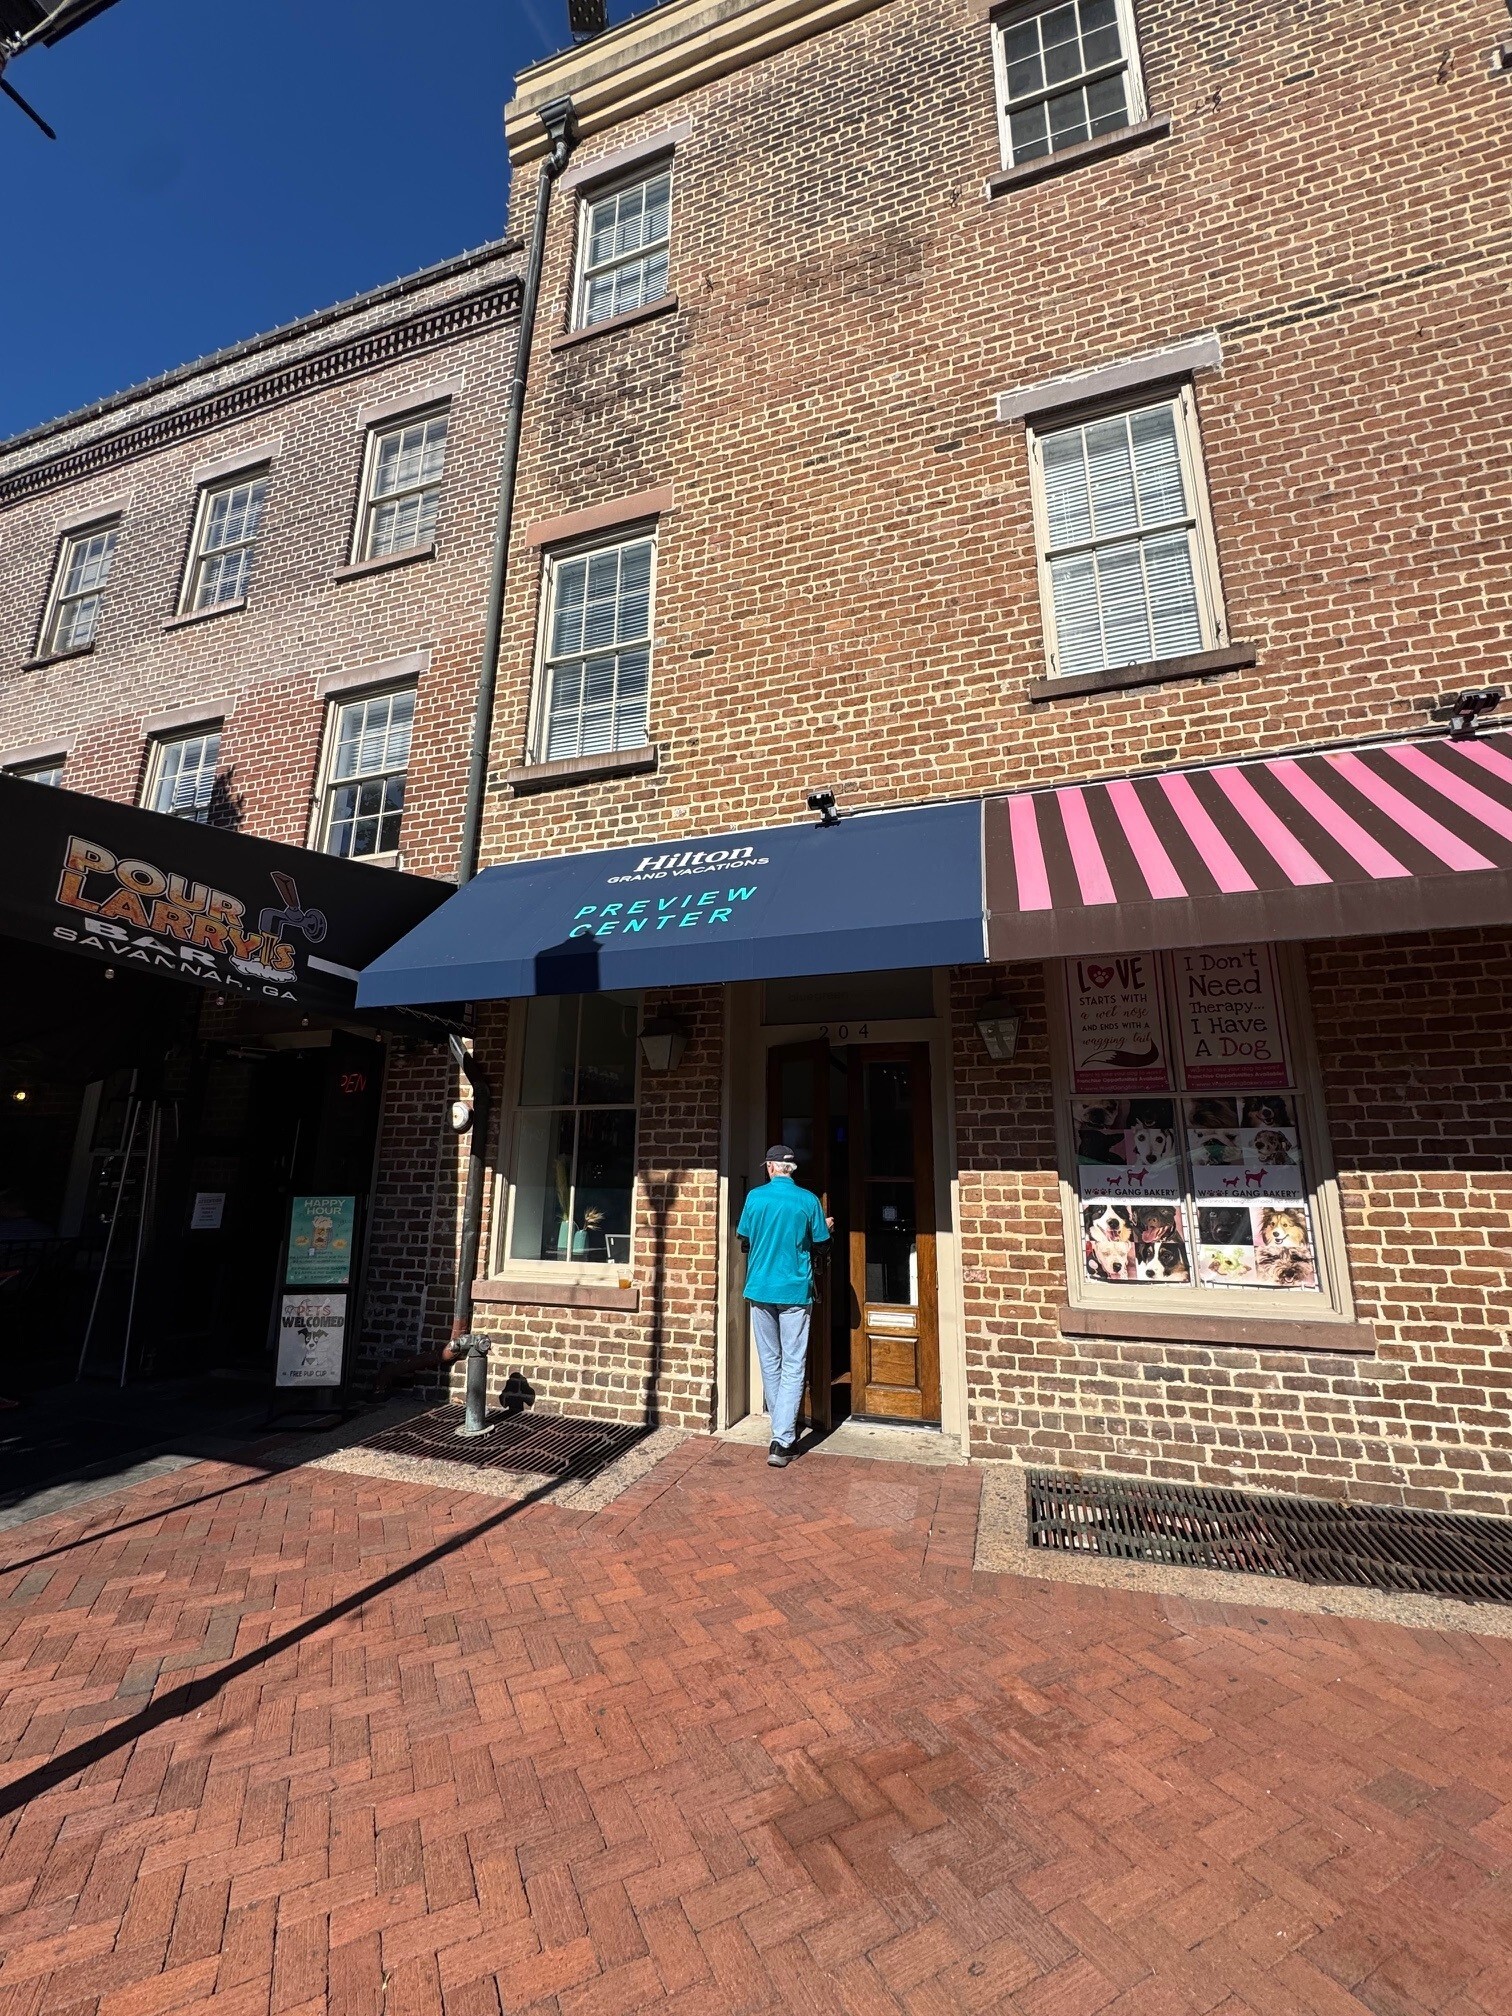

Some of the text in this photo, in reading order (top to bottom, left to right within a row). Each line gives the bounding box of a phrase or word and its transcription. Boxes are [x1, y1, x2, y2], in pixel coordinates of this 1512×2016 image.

[633, 846, 754, 872] Hilton
[607, 857, 770, 884] GRAND VACATIONS
[64, 835, 246, 927] POUR
[574, 886, 758, 920] PREVIEW
[569, 907, 733, 939] CENTER
[84, 917, 218, 969] BAR
[1184, 948, 1258, 971] I Don't
[1189, 969, 1262, 997] Need
[262, 985, 298, 1002] GA
[1080, 994, 1147, 1006] STARTS WITH
[1096, 1005, 1117, 1019] wet
[1124, 1007, 1149, 1018] nose
[1189, 1001, 1264, 1015] Therapy...
[819, 1024, 869, 1040] 204
[1191, 1017, 1268, 1034] I Have
[1083, 1032, 1151, 1050] wagging tail
[1195, 1036, 1271, 1060] A Dog
[1115, 1188, 1141, 1196] GANG
[1144, 1188, 1177, 1196] BAKERY
[304, 1199, 346, 1207] HAPPY
[307, 1207, 342, 1215] HOUR
[297, 1305, 331, 1316] PETS
[282, 1316, 344, 1327] WELCOMED
